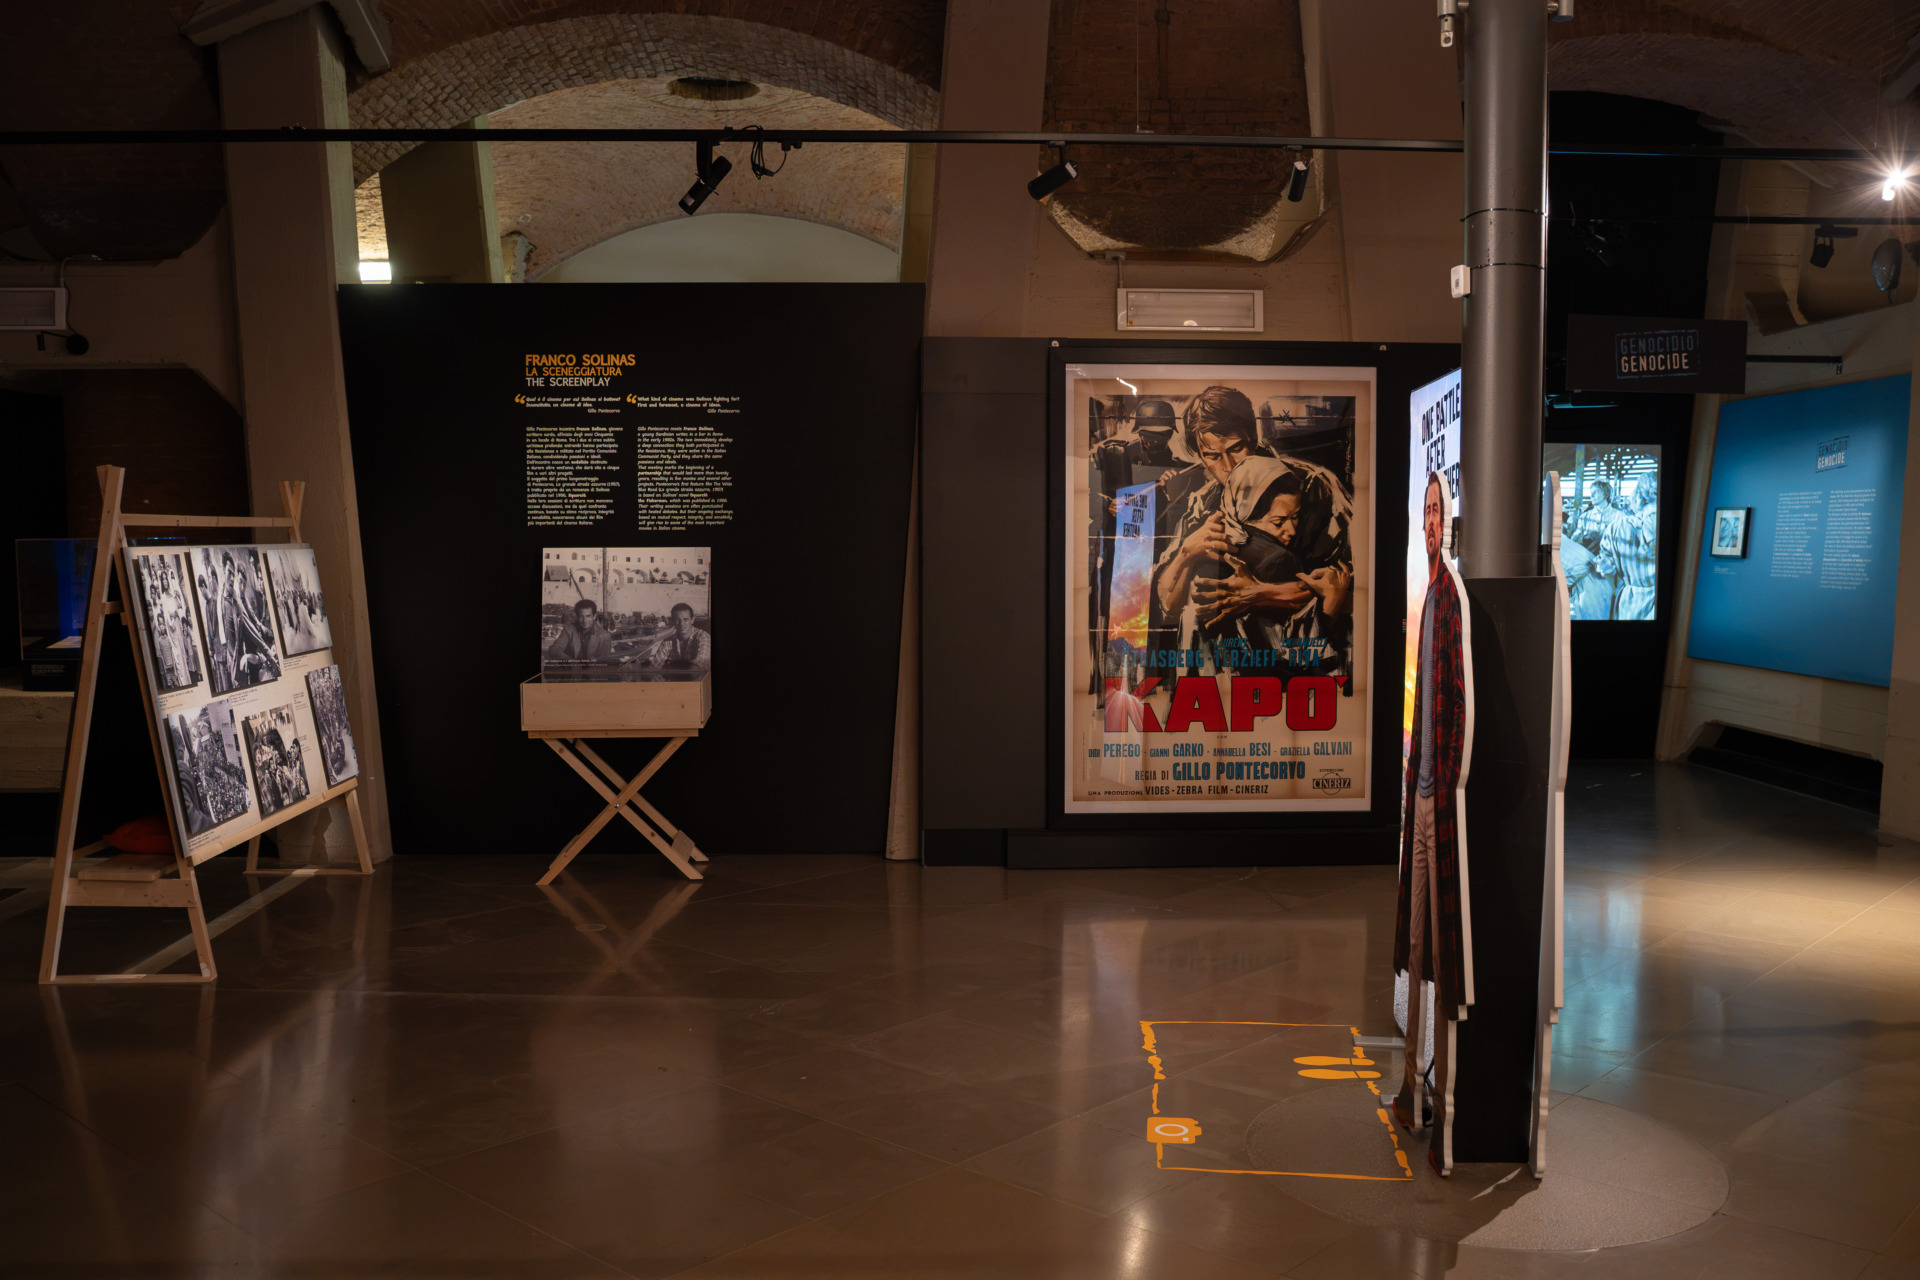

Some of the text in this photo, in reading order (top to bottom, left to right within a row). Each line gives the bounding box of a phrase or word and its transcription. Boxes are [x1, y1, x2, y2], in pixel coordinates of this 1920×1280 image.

[1621, 335, 1694, 355] GENOCIDIO
[526, 354, 636, 366] FRANCO SOLINAS
[1622, 353, 1689, 373] GENOCIDE
[526, 367, 622, 376] LA SCENEGGIATURA
[526, 377, 610, 387] THE SCREENPLAY
[1422, 382, 1460, 445] ONE BATTLE
[1426, 433, 1445, 478] AFTER
[1818, 451, 1845, 469] GENOCIDE
[1122, 649, 1320, 668] STRASBERG TERZIEFF RIVA
[1104, 744, 1141, 758] PEREGO
[1150, 748, 1170, 758] GIANNI
[1172, 743, 1204, 757] GARKO
[1213, 747, 1246, 757] ANNABELLA
[1250, 742, 1271, 756] BESI
[1280, 746, 1311, 756] GRAZIELLA
[1314, 741, 1352, 756] GALVANI
[1135, 761, 1306, 781] REGIA DI GILLO PONTECORVO
[1145, 786, 1170, 796] VIDES
[1176, 786, 1203, 795] ZEBRA
[1208, 785, 1228, 794] FILM
[1235, 784, 1269, 794] CINERIZ
[1312, 778, 1351, 789] CINERIZ
